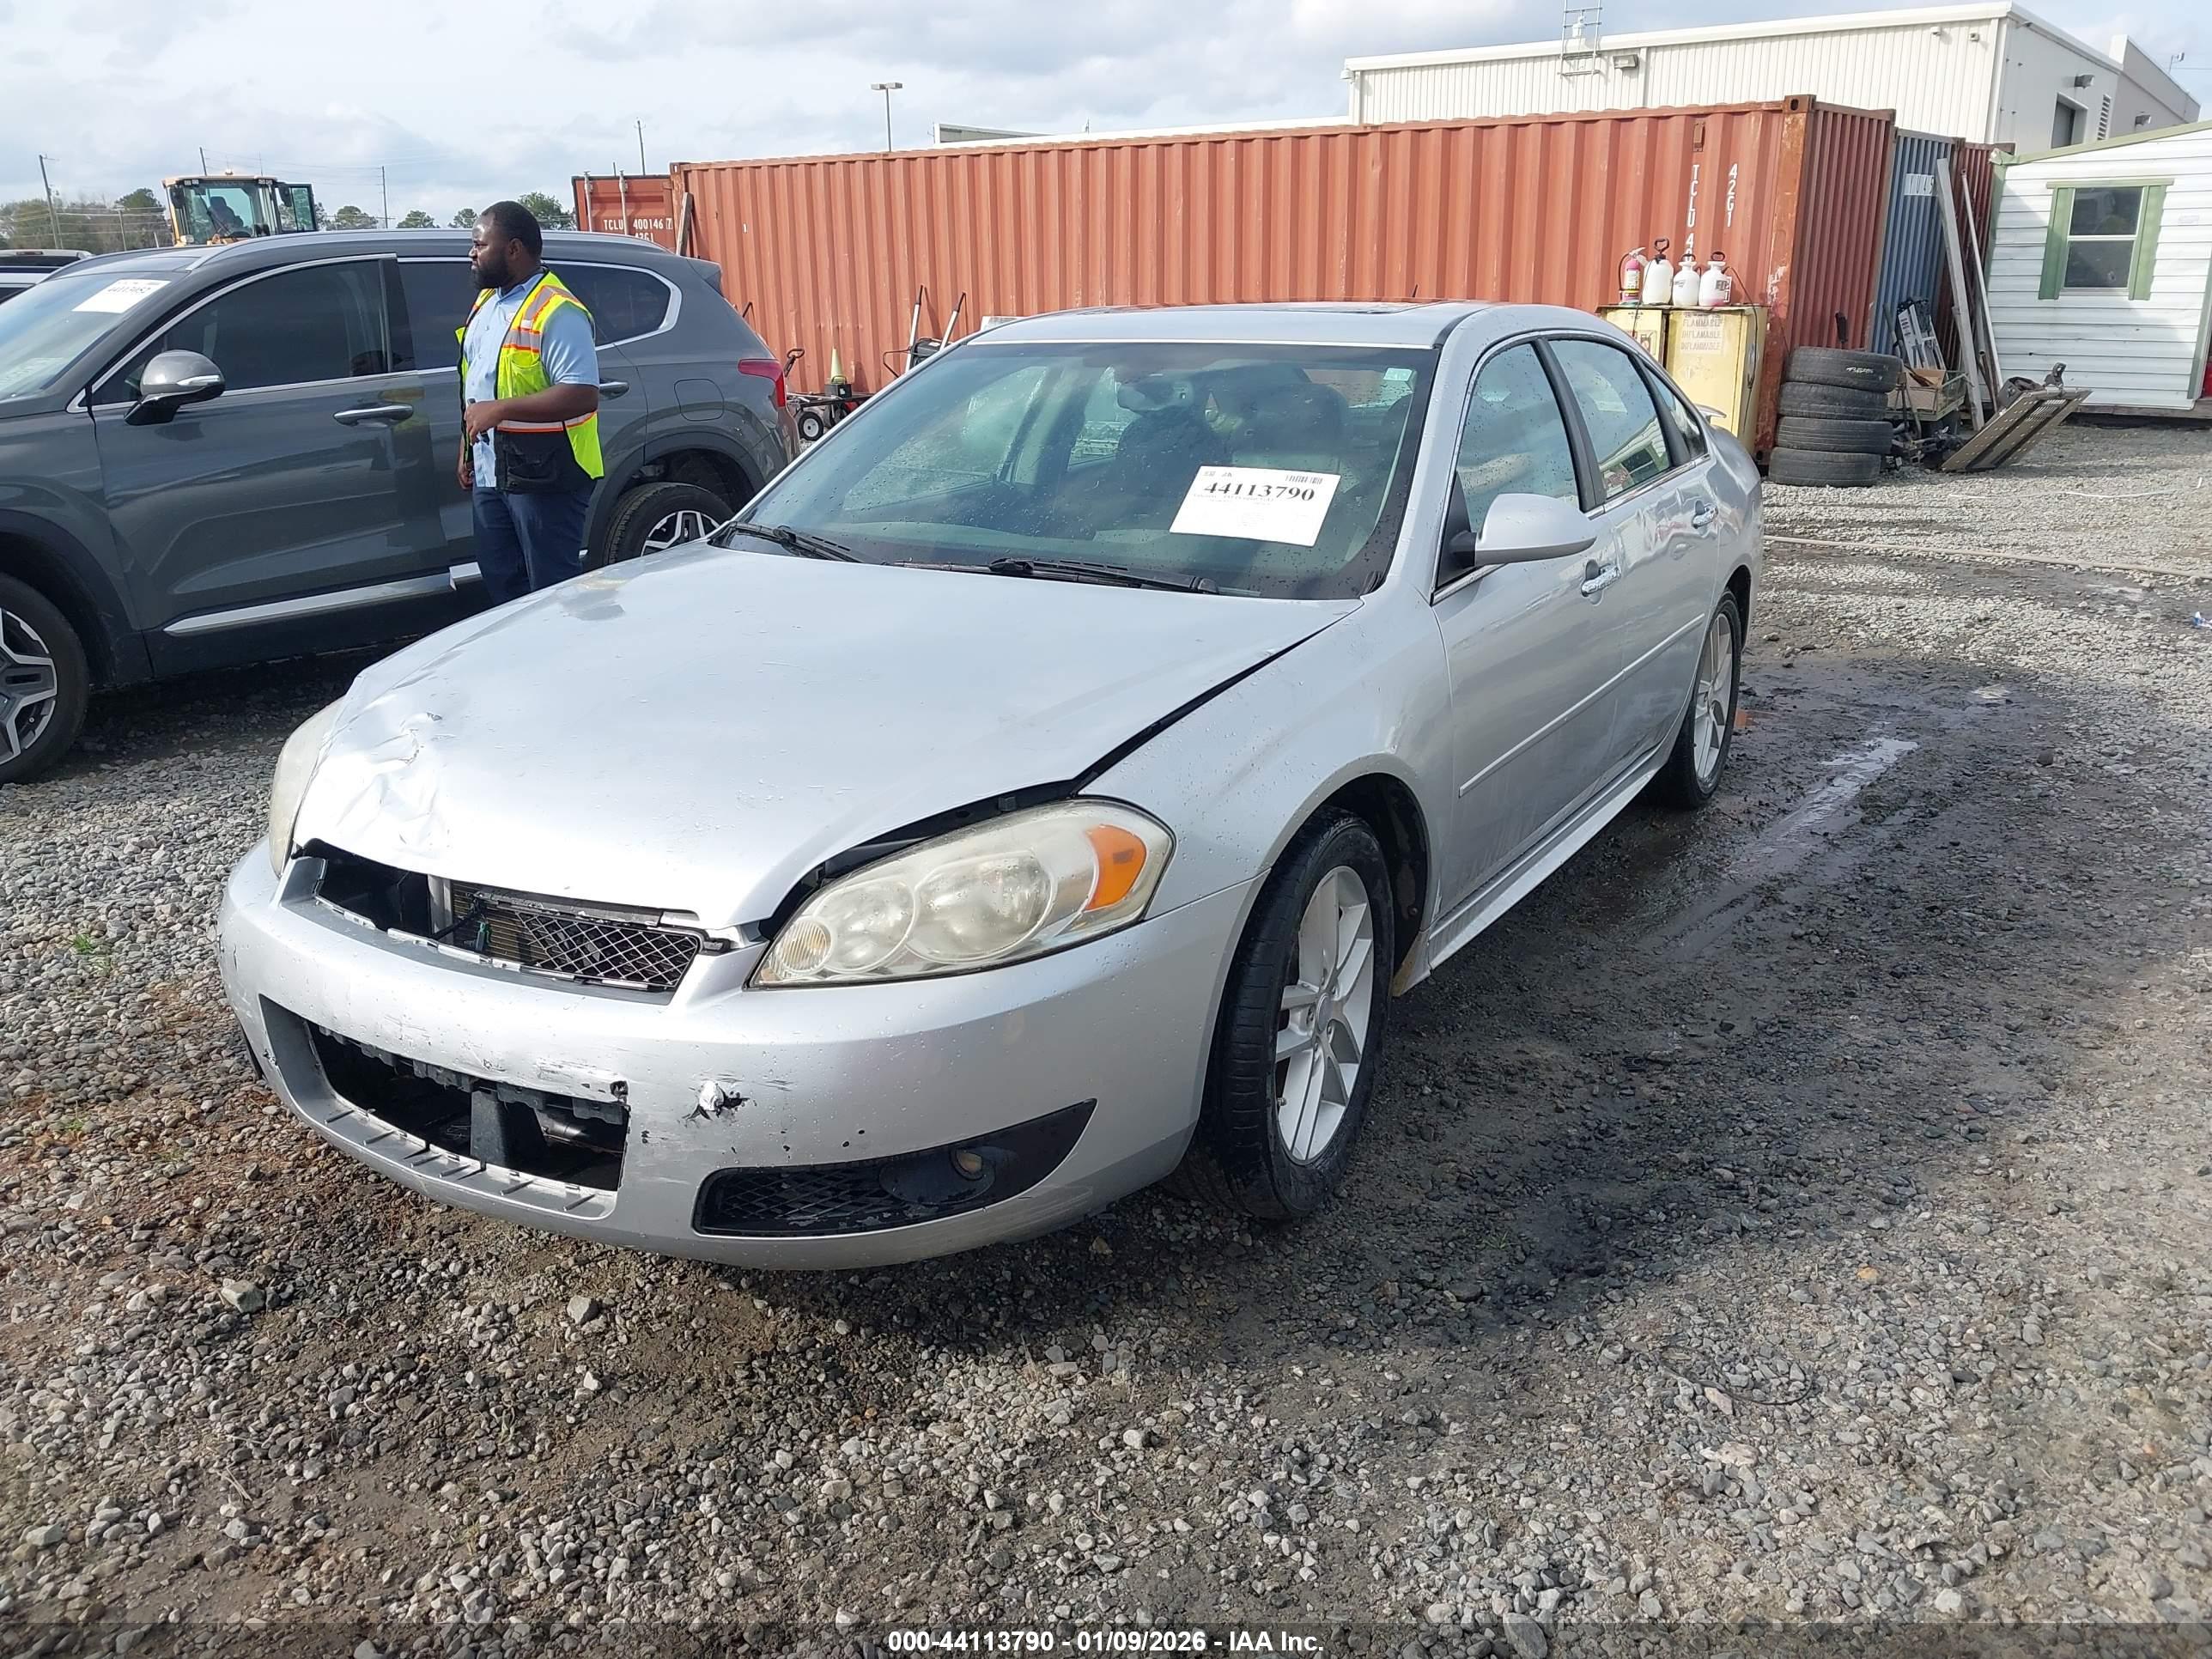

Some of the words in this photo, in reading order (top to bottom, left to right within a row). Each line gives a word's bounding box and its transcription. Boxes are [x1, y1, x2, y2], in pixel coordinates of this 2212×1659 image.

[1686, 164, 1700, 228] TCLU
[1727, 163, 1738, 228] 42G1
[603, 219, 624, 231] TCLU
[633, 217, 664, 230] 400146
[1204, 482, 1316, 501] 44113790
